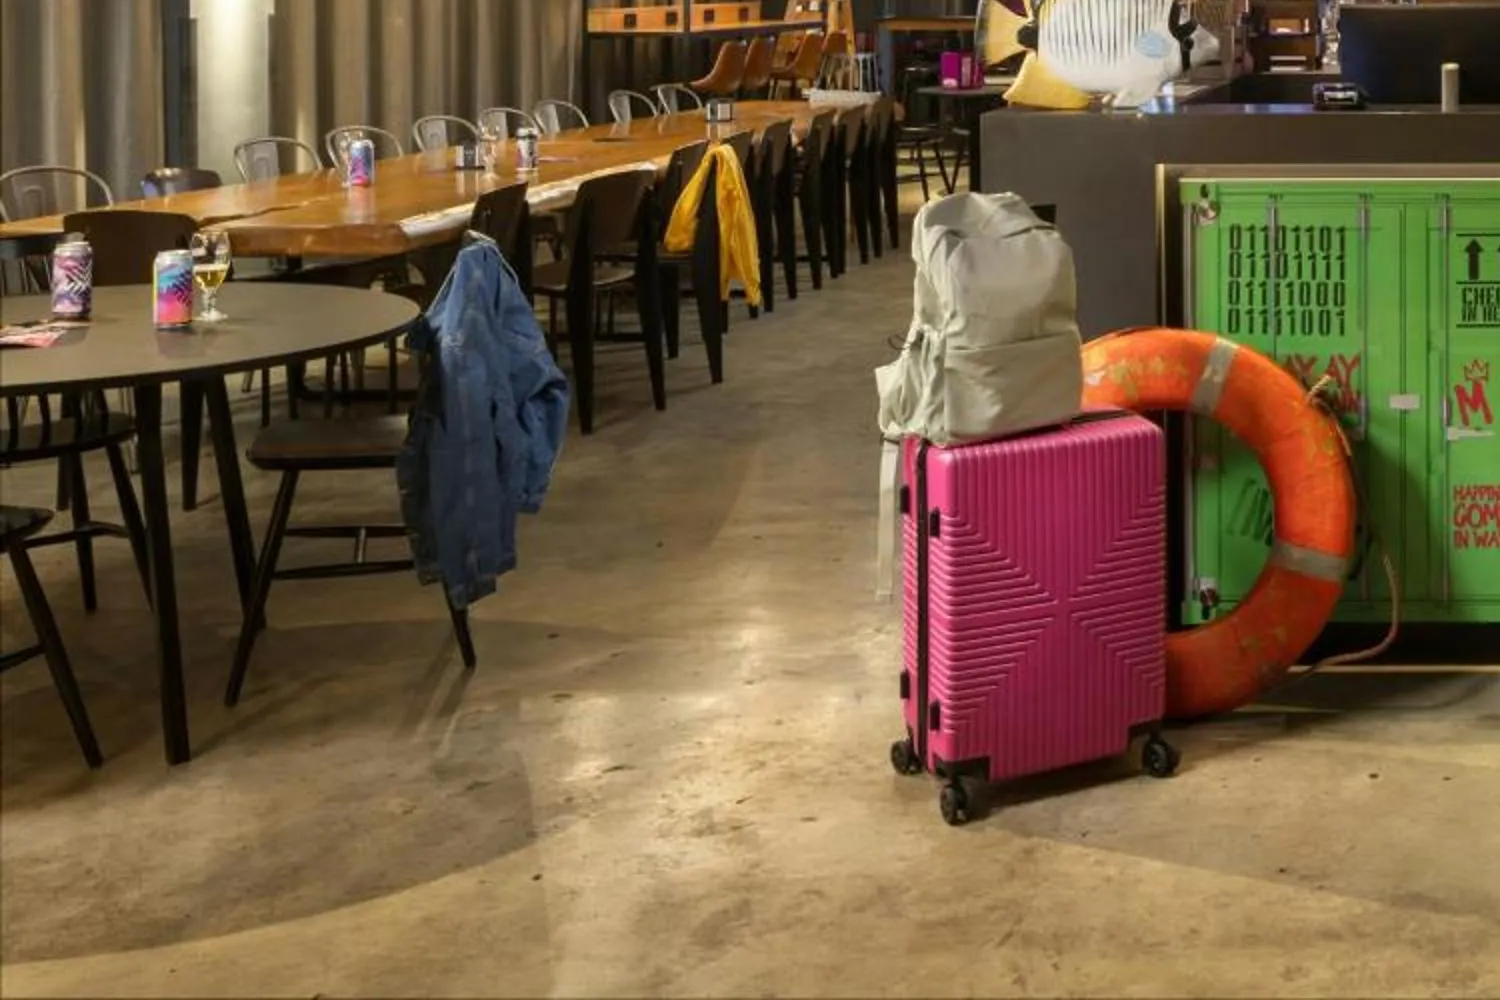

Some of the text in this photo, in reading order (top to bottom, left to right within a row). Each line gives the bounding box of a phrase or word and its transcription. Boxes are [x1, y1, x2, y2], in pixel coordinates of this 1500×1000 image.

[1228, 224, 1345, 252] 01101101
[1228, 252, 1345, 280] 01101111
[1227, 280, 1345, 307] 01111000
[1227, 307, 1345, 336] 01111001
[1454, 379, 1494, 427] M
[1453, 530, 1469, 549] IN
